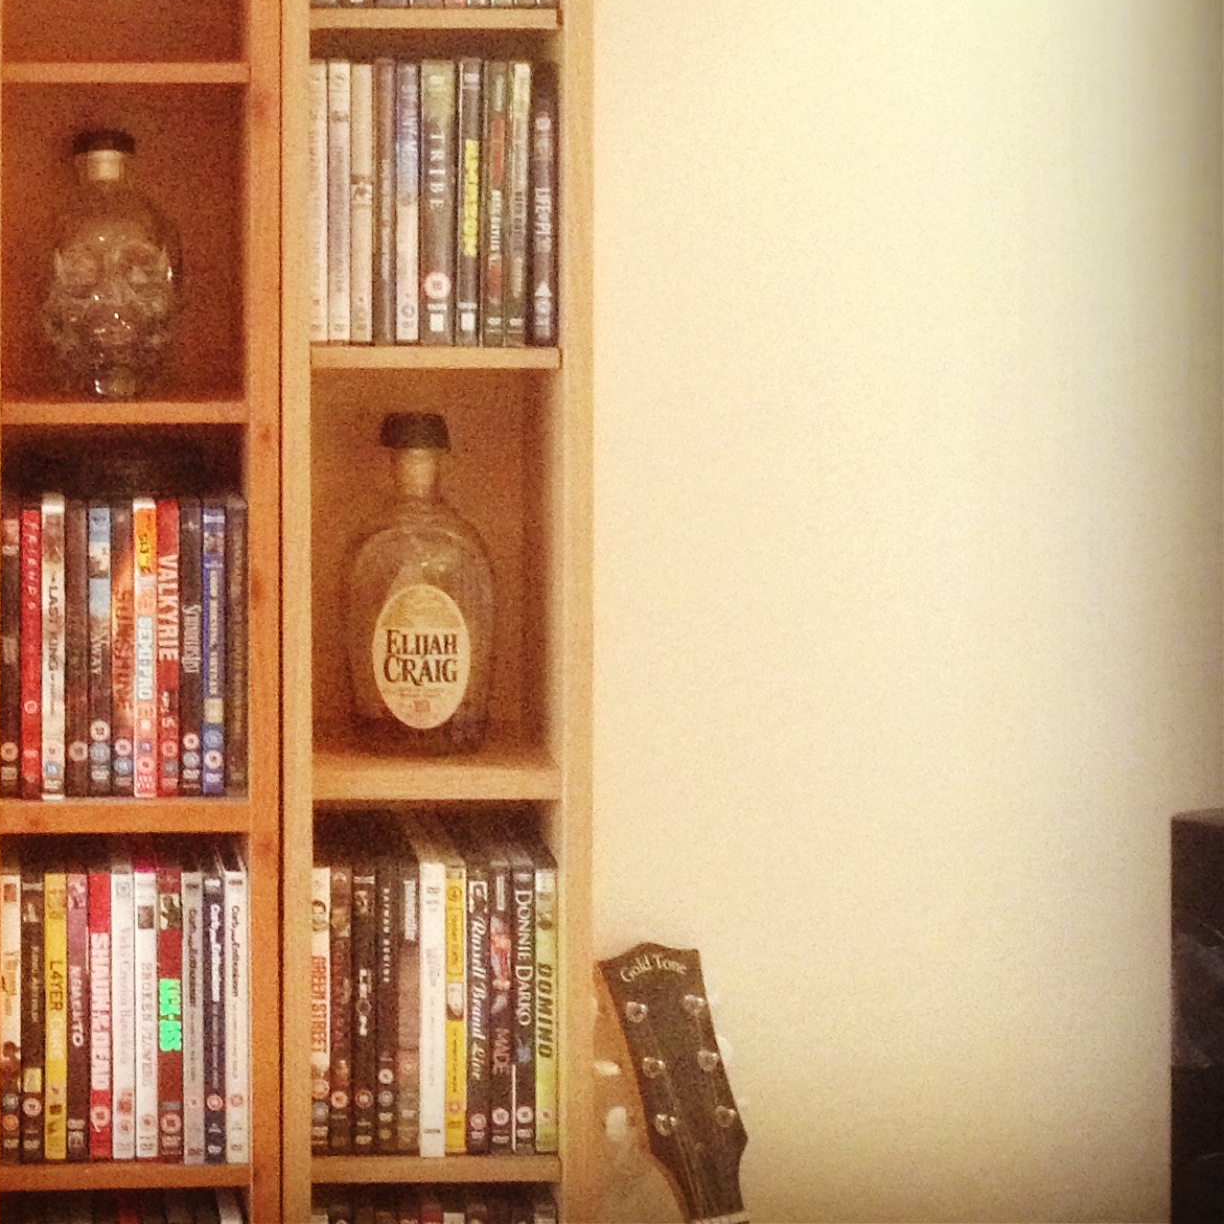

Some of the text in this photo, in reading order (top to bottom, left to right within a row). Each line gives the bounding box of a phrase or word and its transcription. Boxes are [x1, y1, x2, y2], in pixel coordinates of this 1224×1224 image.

[428, 129, 446, 211] TRIBE
[535, 187, 552, 213] LIFE
[48, 585, 59, 624] LAST
[157, 553, 179, 661] VALKYRIE
[48, 633, 59, 671] KING
[90, 631, 103, 676] AWAY
[137, 616, 155, 700] SEMI-PRO
[383, 655, 458, 686] CRAIG
[385, 628, 458, 657] ELIJAH
[49, 960, 64, 1012] L4YER
[232, 905, 241, 997] Curb Enthusiasm
[514, 889, 534, 1027] DONNIE DARKO
[619, 953, 689, 984] Gold Tone
[68, 964, 84, 1048] MEMENTO
[91, 933, 111, 1091] SHAUN DEAD
[142, 963, 153, 1022] BROKEN
[312, 955, 327, 1054] GREEN STREET
[471, 915, 487, 1081] Russell Brand Live
[537, 962, 554, 1059] DOMINO
[493, 1027, 511, 1076] MADE
